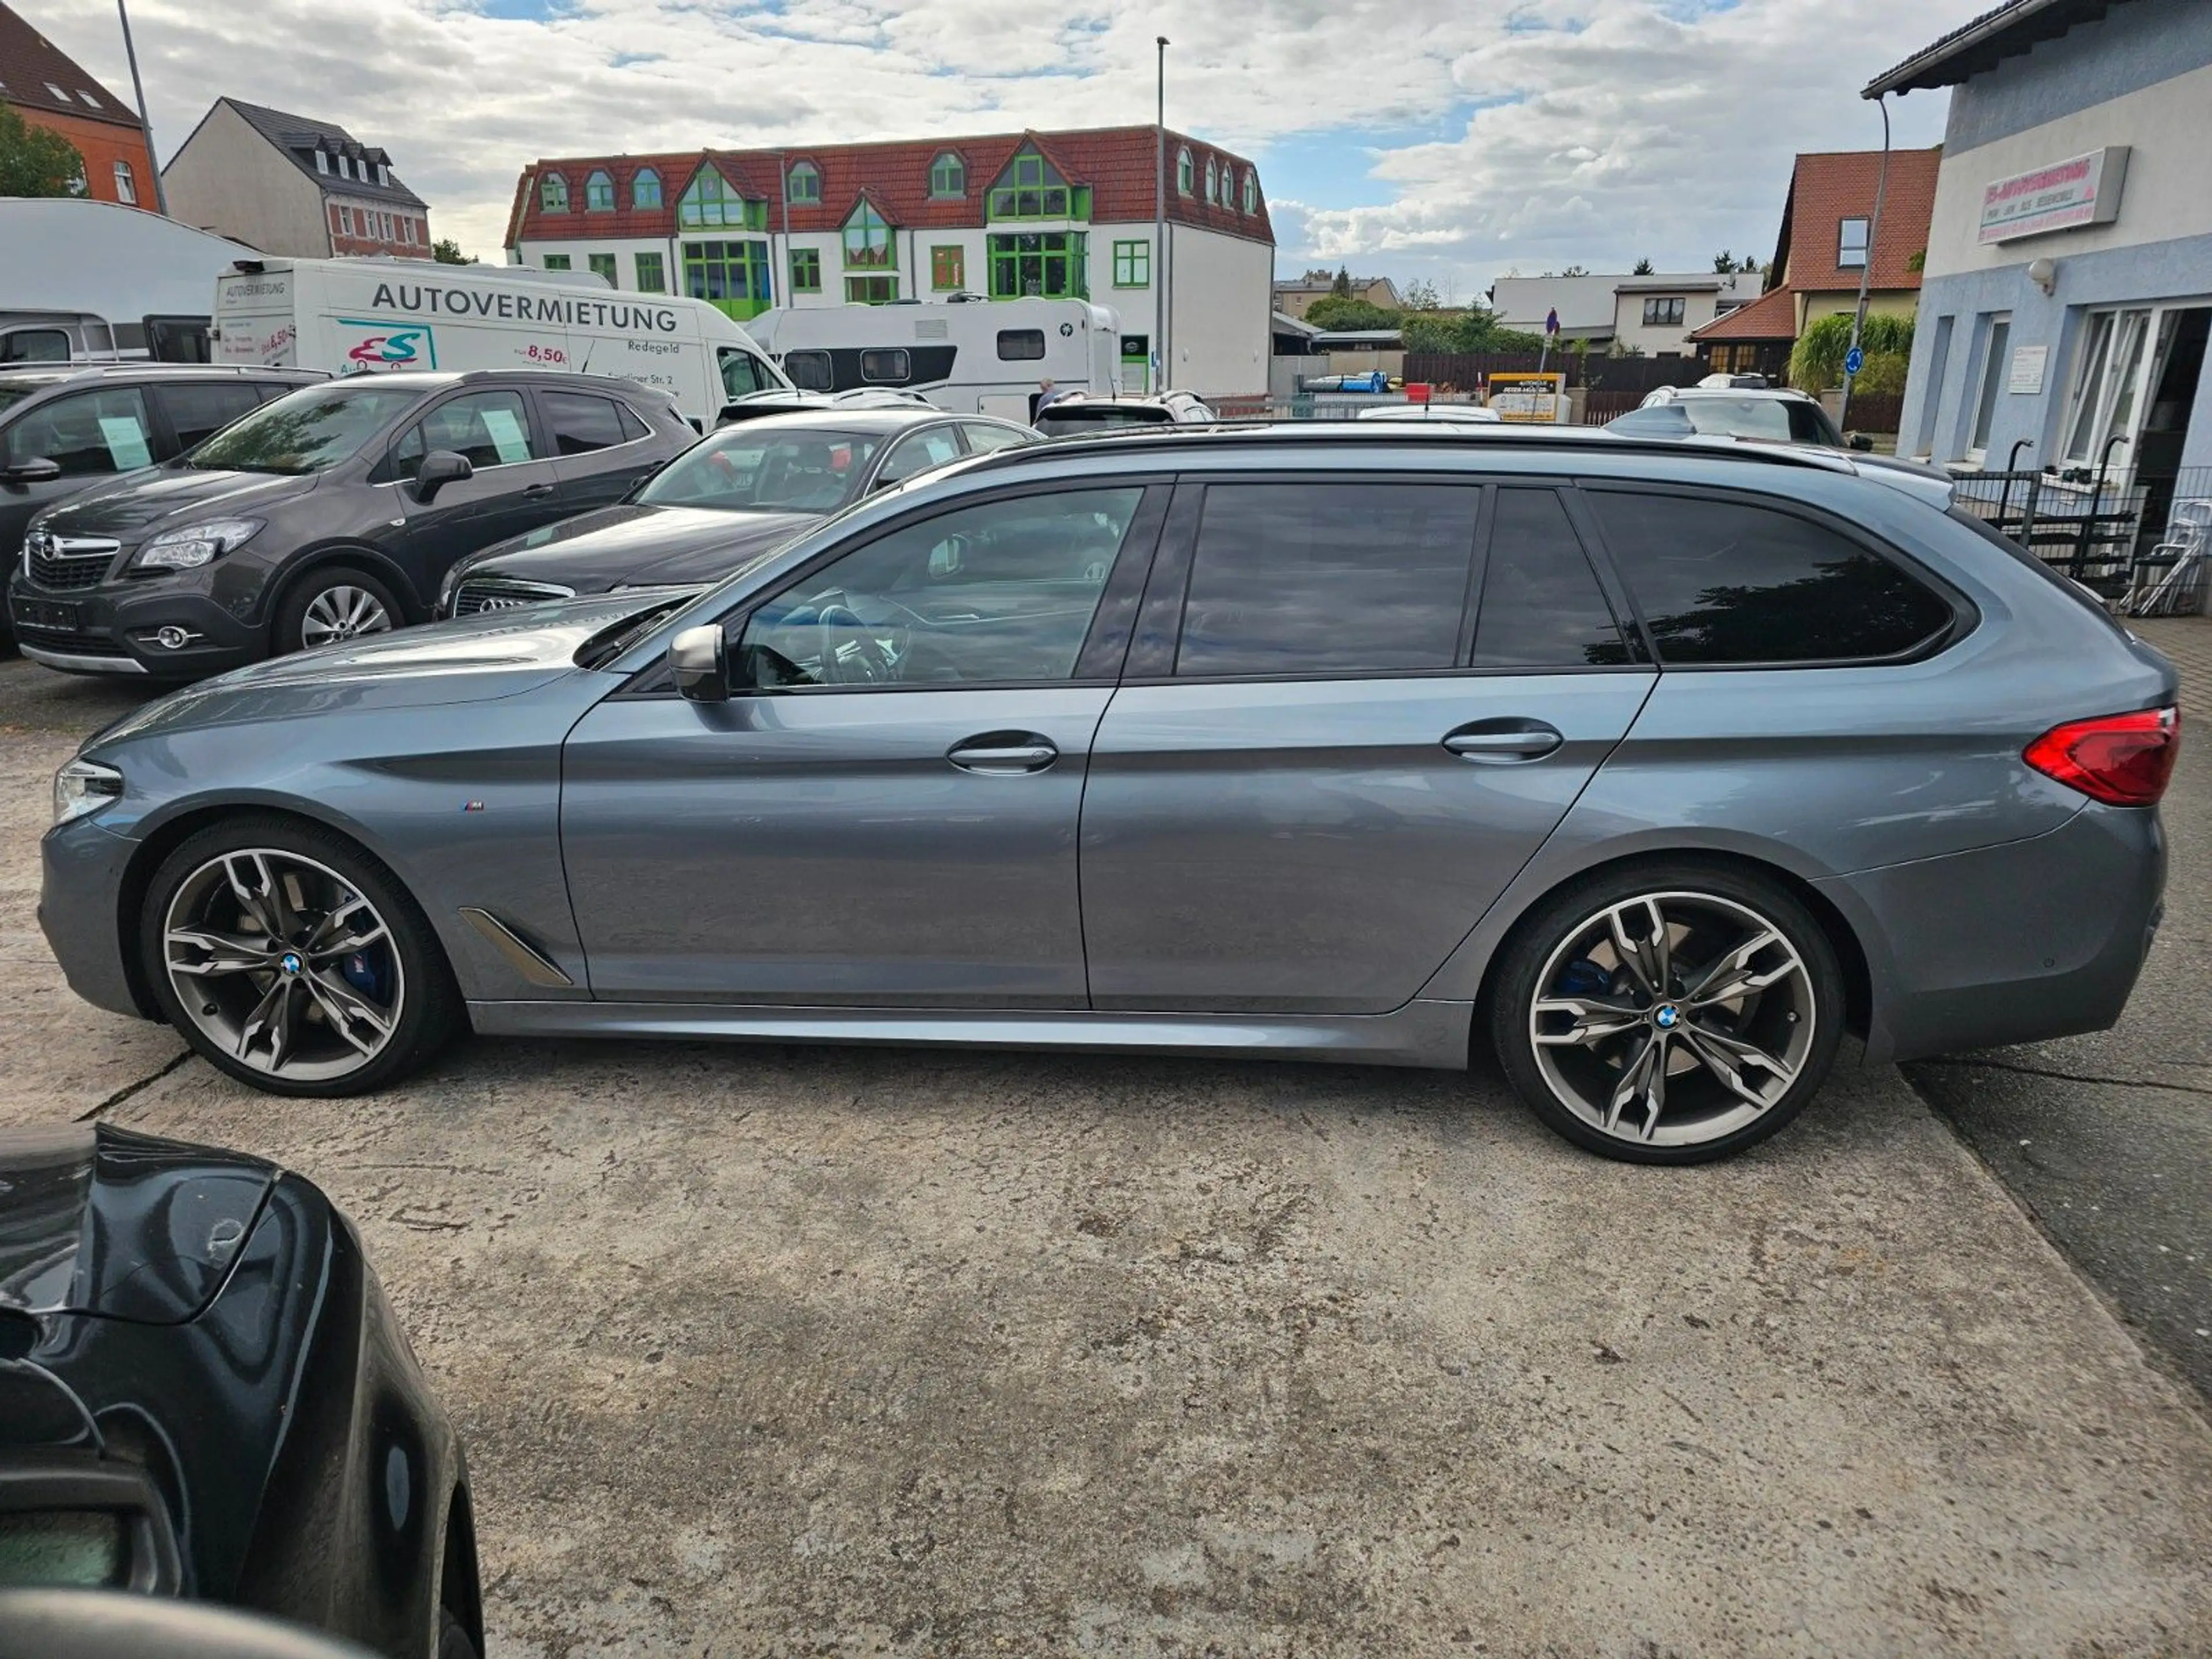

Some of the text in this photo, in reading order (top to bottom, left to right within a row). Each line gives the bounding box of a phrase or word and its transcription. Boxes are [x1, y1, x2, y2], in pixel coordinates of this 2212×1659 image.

[372, 283, 677, 332] AUTOVERMIETUNG
[349, 332, 421, 363] ES
[628, 340, 680, 355] Redegeld
[650, 374, 665, 384] Str.
[666, 376, 673, 385] 2
